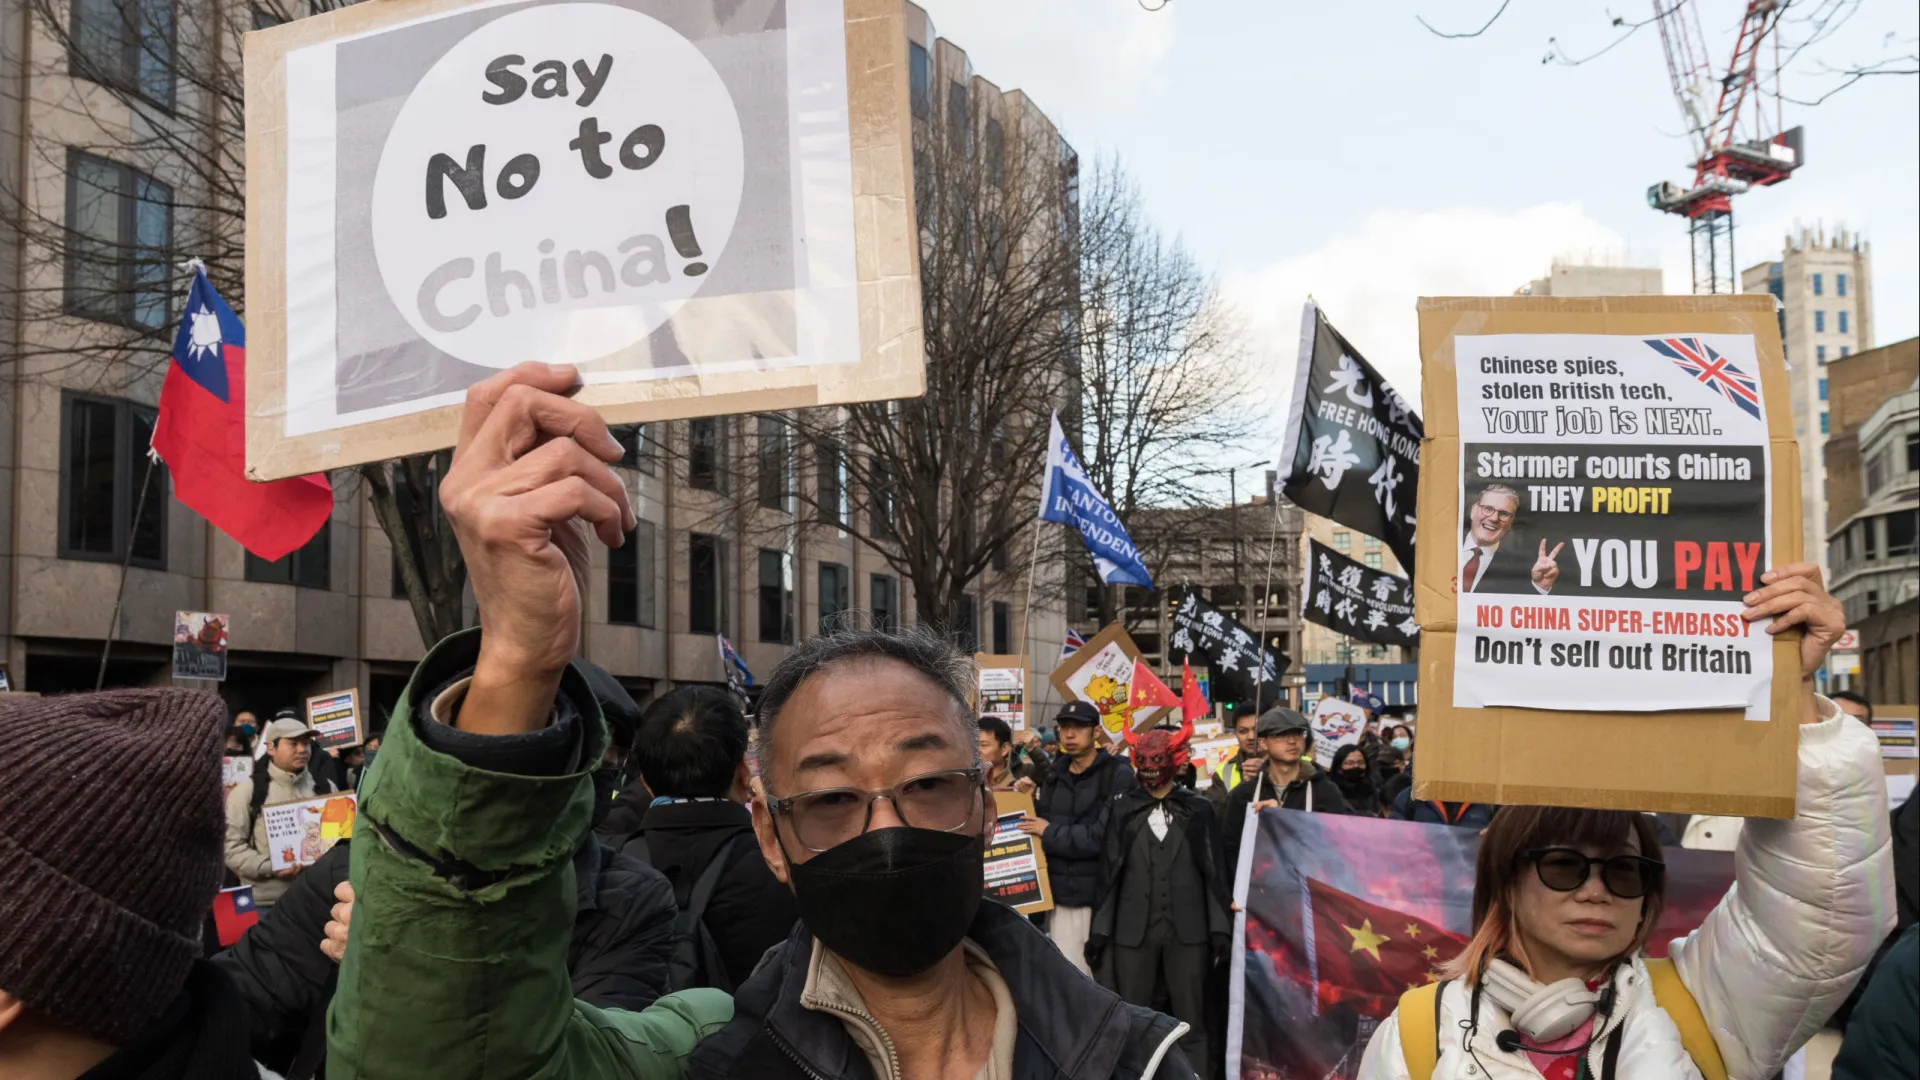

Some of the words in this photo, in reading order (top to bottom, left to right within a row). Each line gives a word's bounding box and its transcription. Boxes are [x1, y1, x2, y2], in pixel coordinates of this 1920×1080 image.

[482, 53, 614, 107] Say
[425, 143, 541, 220] No
[569, 116, 666, 180] to
[416, 203, 709, 334] China!
[1480, 356, 1558, 375] Chinese
[1563, 356, 1624, 377] spies,
[1481, 381, 1544, 400] stolen
[1549, 381, 1614, 400] British
[1620, 383, 1672, 402] tech,
[1317, 400, 1357, 428] FREE
[1356, 412, 1390, 445] HONG
[1482, 406, 1548, 435] Your
[1555, 406, 1603, 436] job
[1609, 407, 1638, 435] is
[1644, 407, 1722, 436] NEXT.
[1477, 451, 1579, 479] Starmer
[1586, 453, 1671, 480] courts
[1677, 453, 1751, 481] China
[1306, 429, 1417, 546] 時代
[1528, 485, 1585, 513] THEY
[1591, 486, 1672, 514] PROFIT
[1571, 538, 1658, 589] YOU
[1674, 541, 1761, 592] PAY
[1203, 625, 1223, 641] KONG
[1476, 604, 1502, 629] NO
[1510, 606, 1571, 631] CHINA
[1577, 608, 1751, 638] SUPER-EMBASSY
[1474, 636, 1543, 667] Don't
[1550, 640, 1600, 668] sell
[1609, 644, 1652, 671] out
[1661, 643, 1752, 674] Britain
